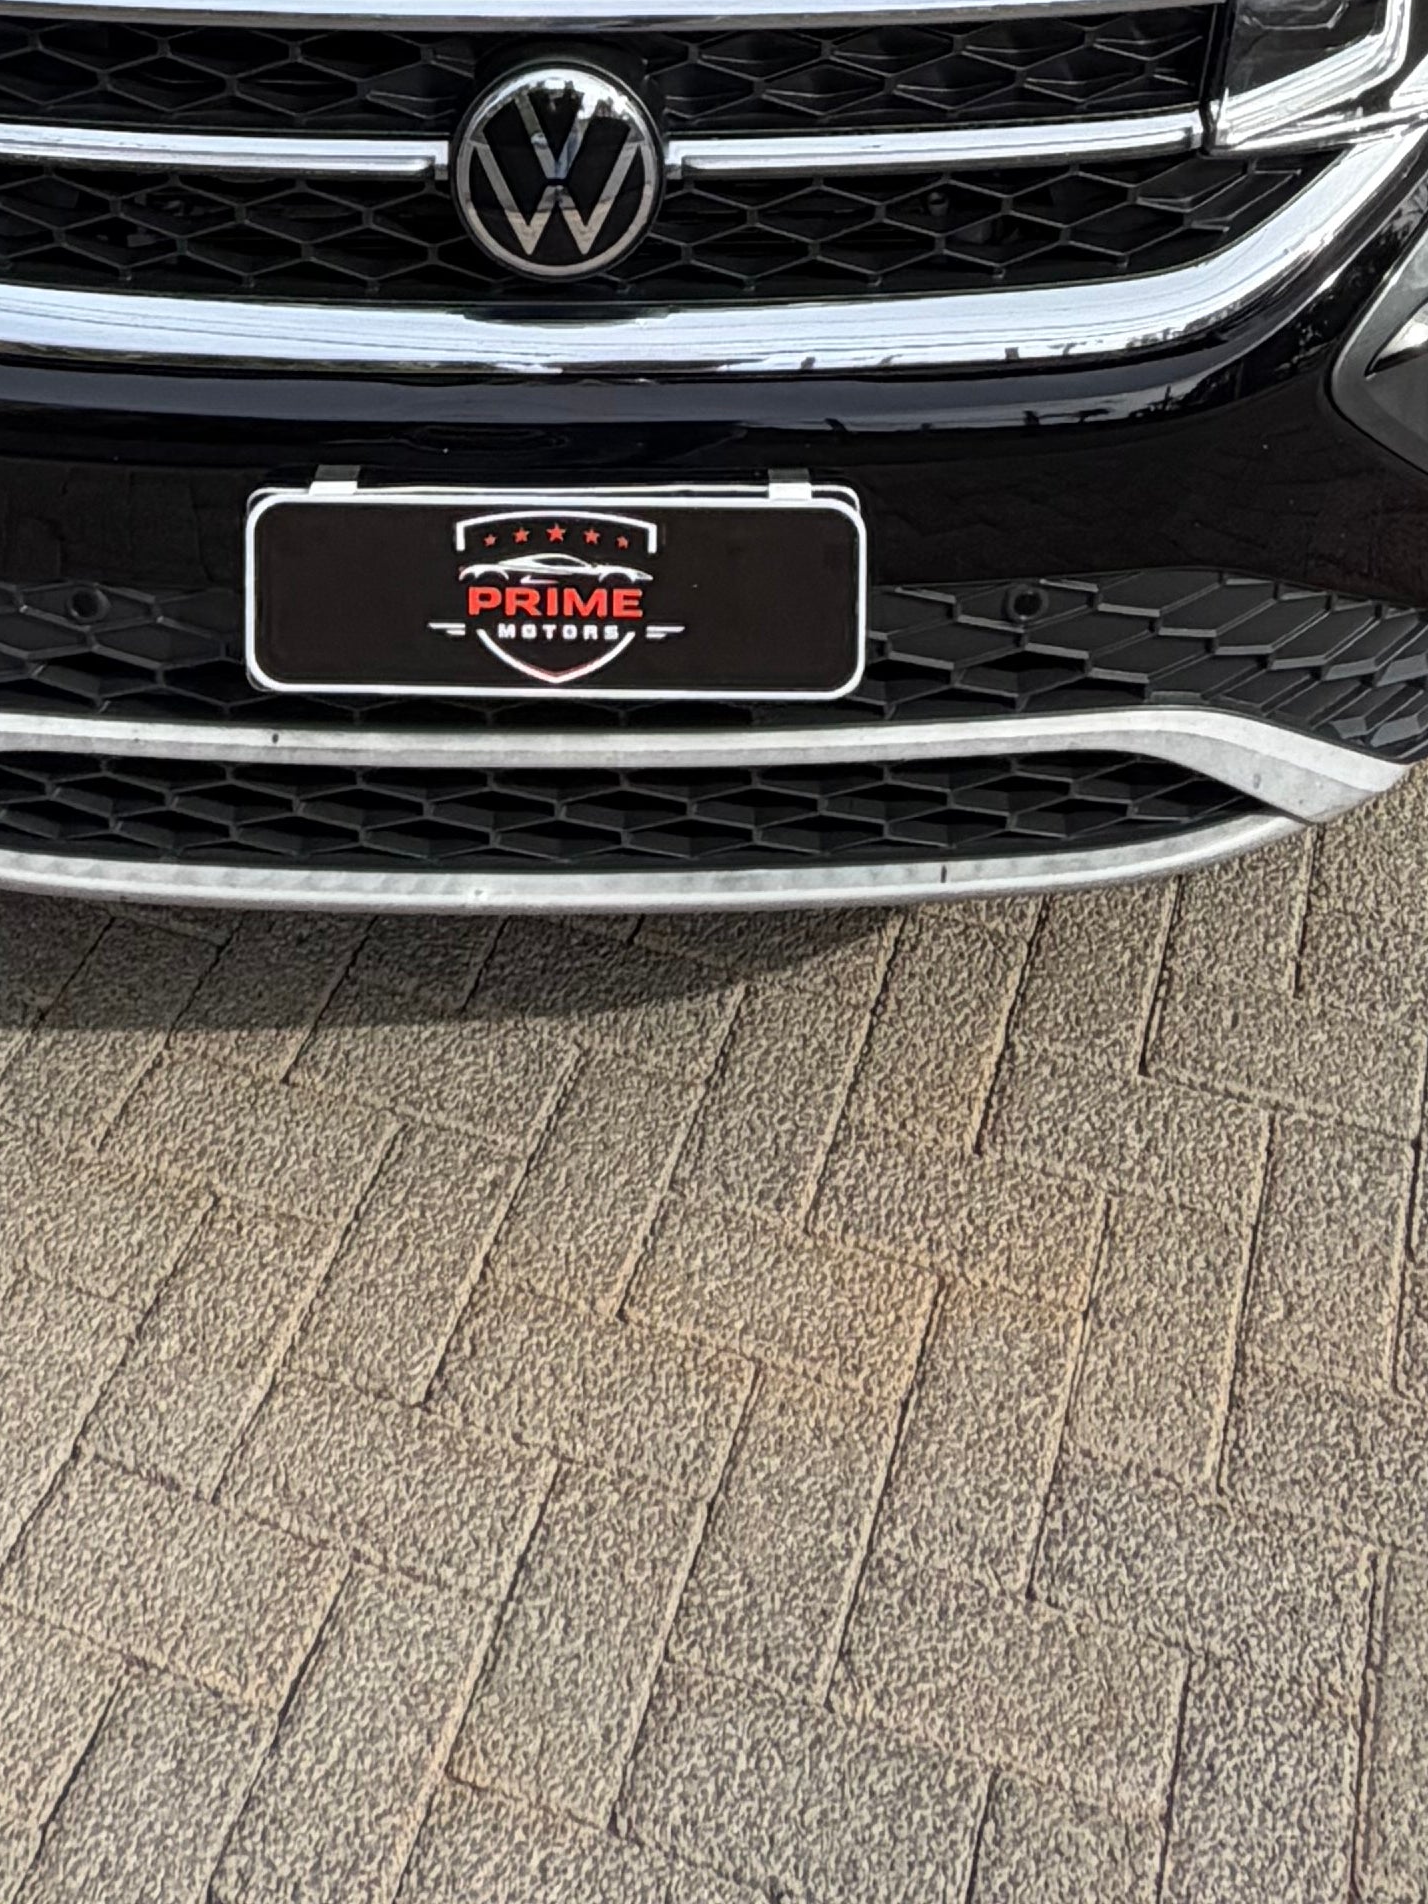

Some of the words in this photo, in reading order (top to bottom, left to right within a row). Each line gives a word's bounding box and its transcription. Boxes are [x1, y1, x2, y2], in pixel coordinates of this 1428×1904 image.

[467, 88, 644, 256] VW
[468, 586, 643, 618] PRIME
[497, 623, 619, 640] MOTORS
